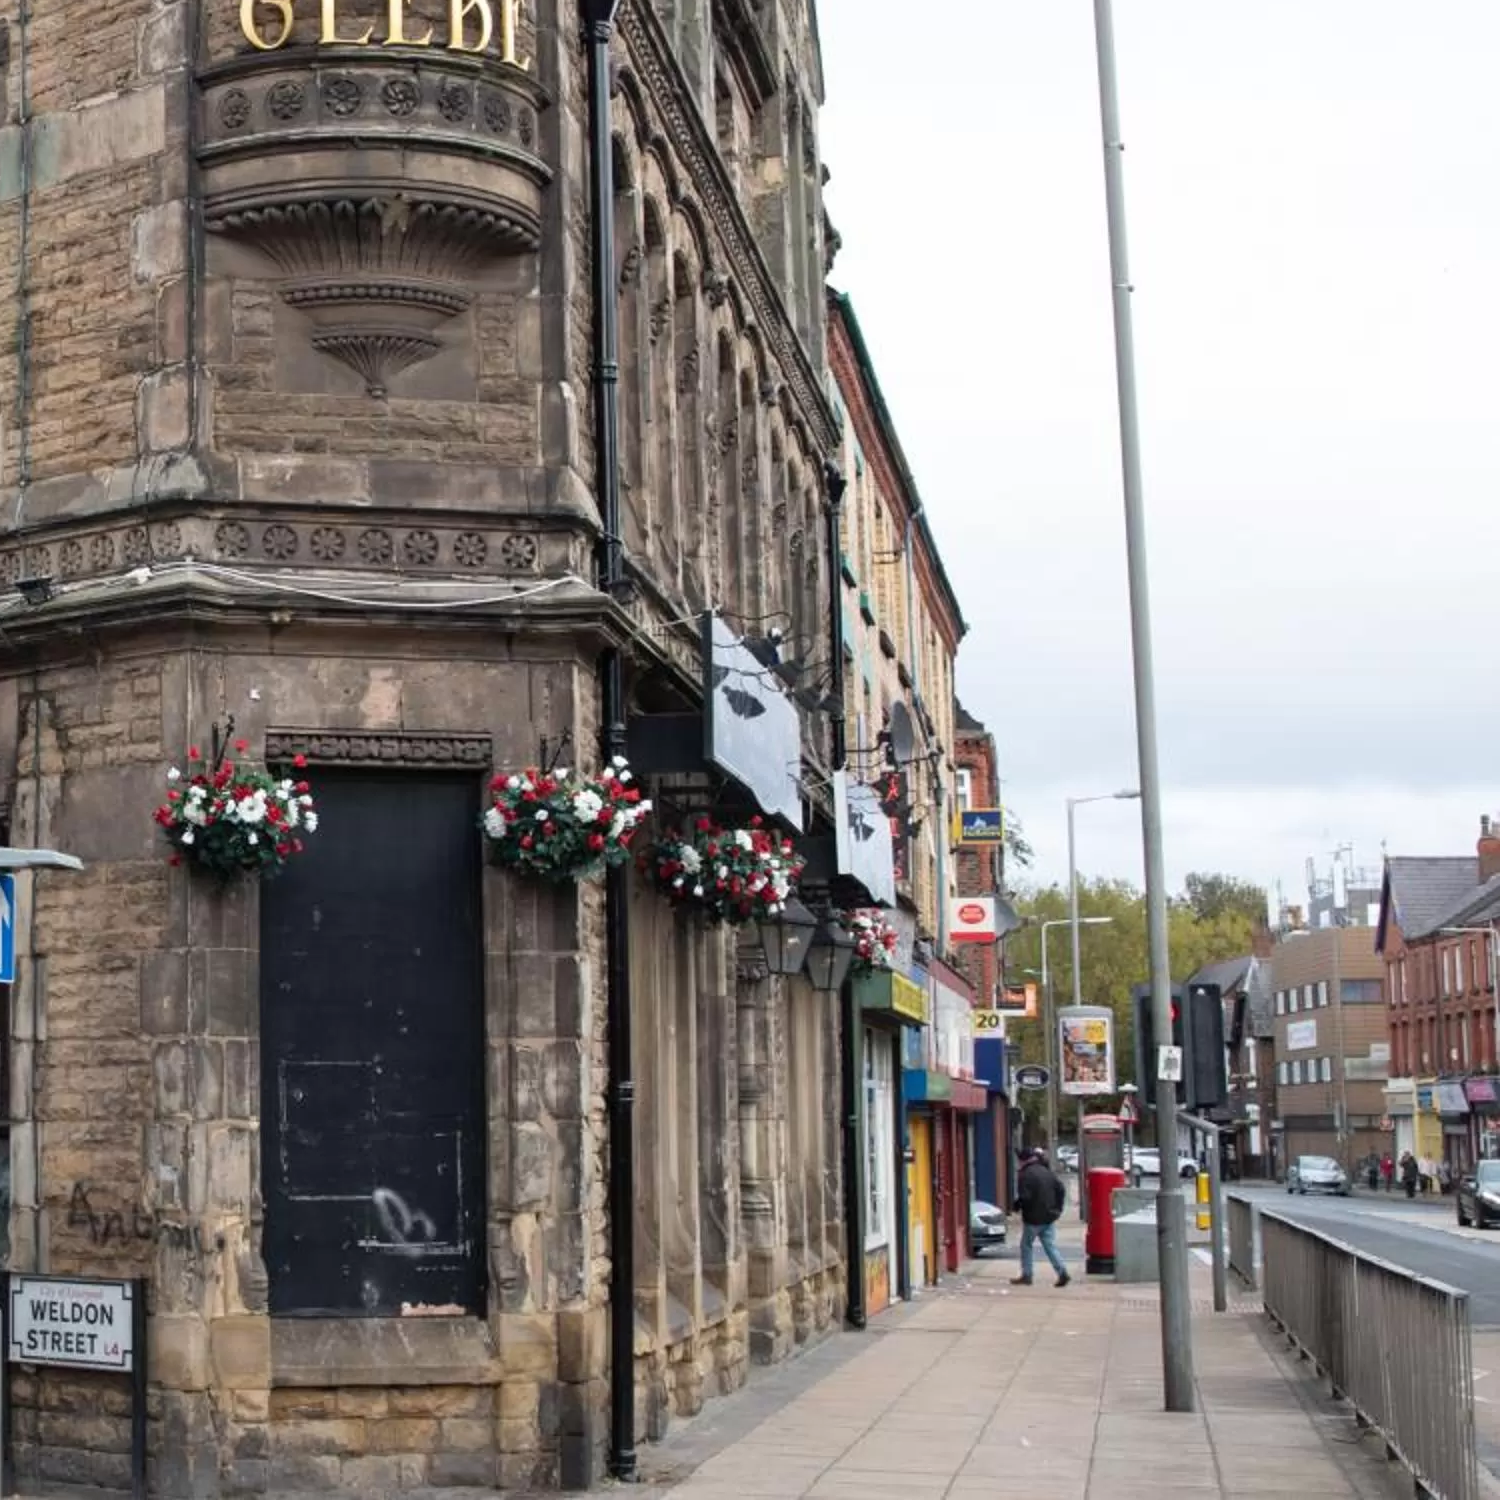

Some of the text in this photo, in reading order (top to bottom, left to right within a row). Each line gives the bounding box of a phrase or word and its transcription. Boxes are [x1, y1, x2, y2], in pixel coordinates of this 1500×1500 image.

[977, 1014, 999, 1028] 20
[30, 1300, 113, 1326] WELDON
[27, 1329, 119, 1356] STREET L4
